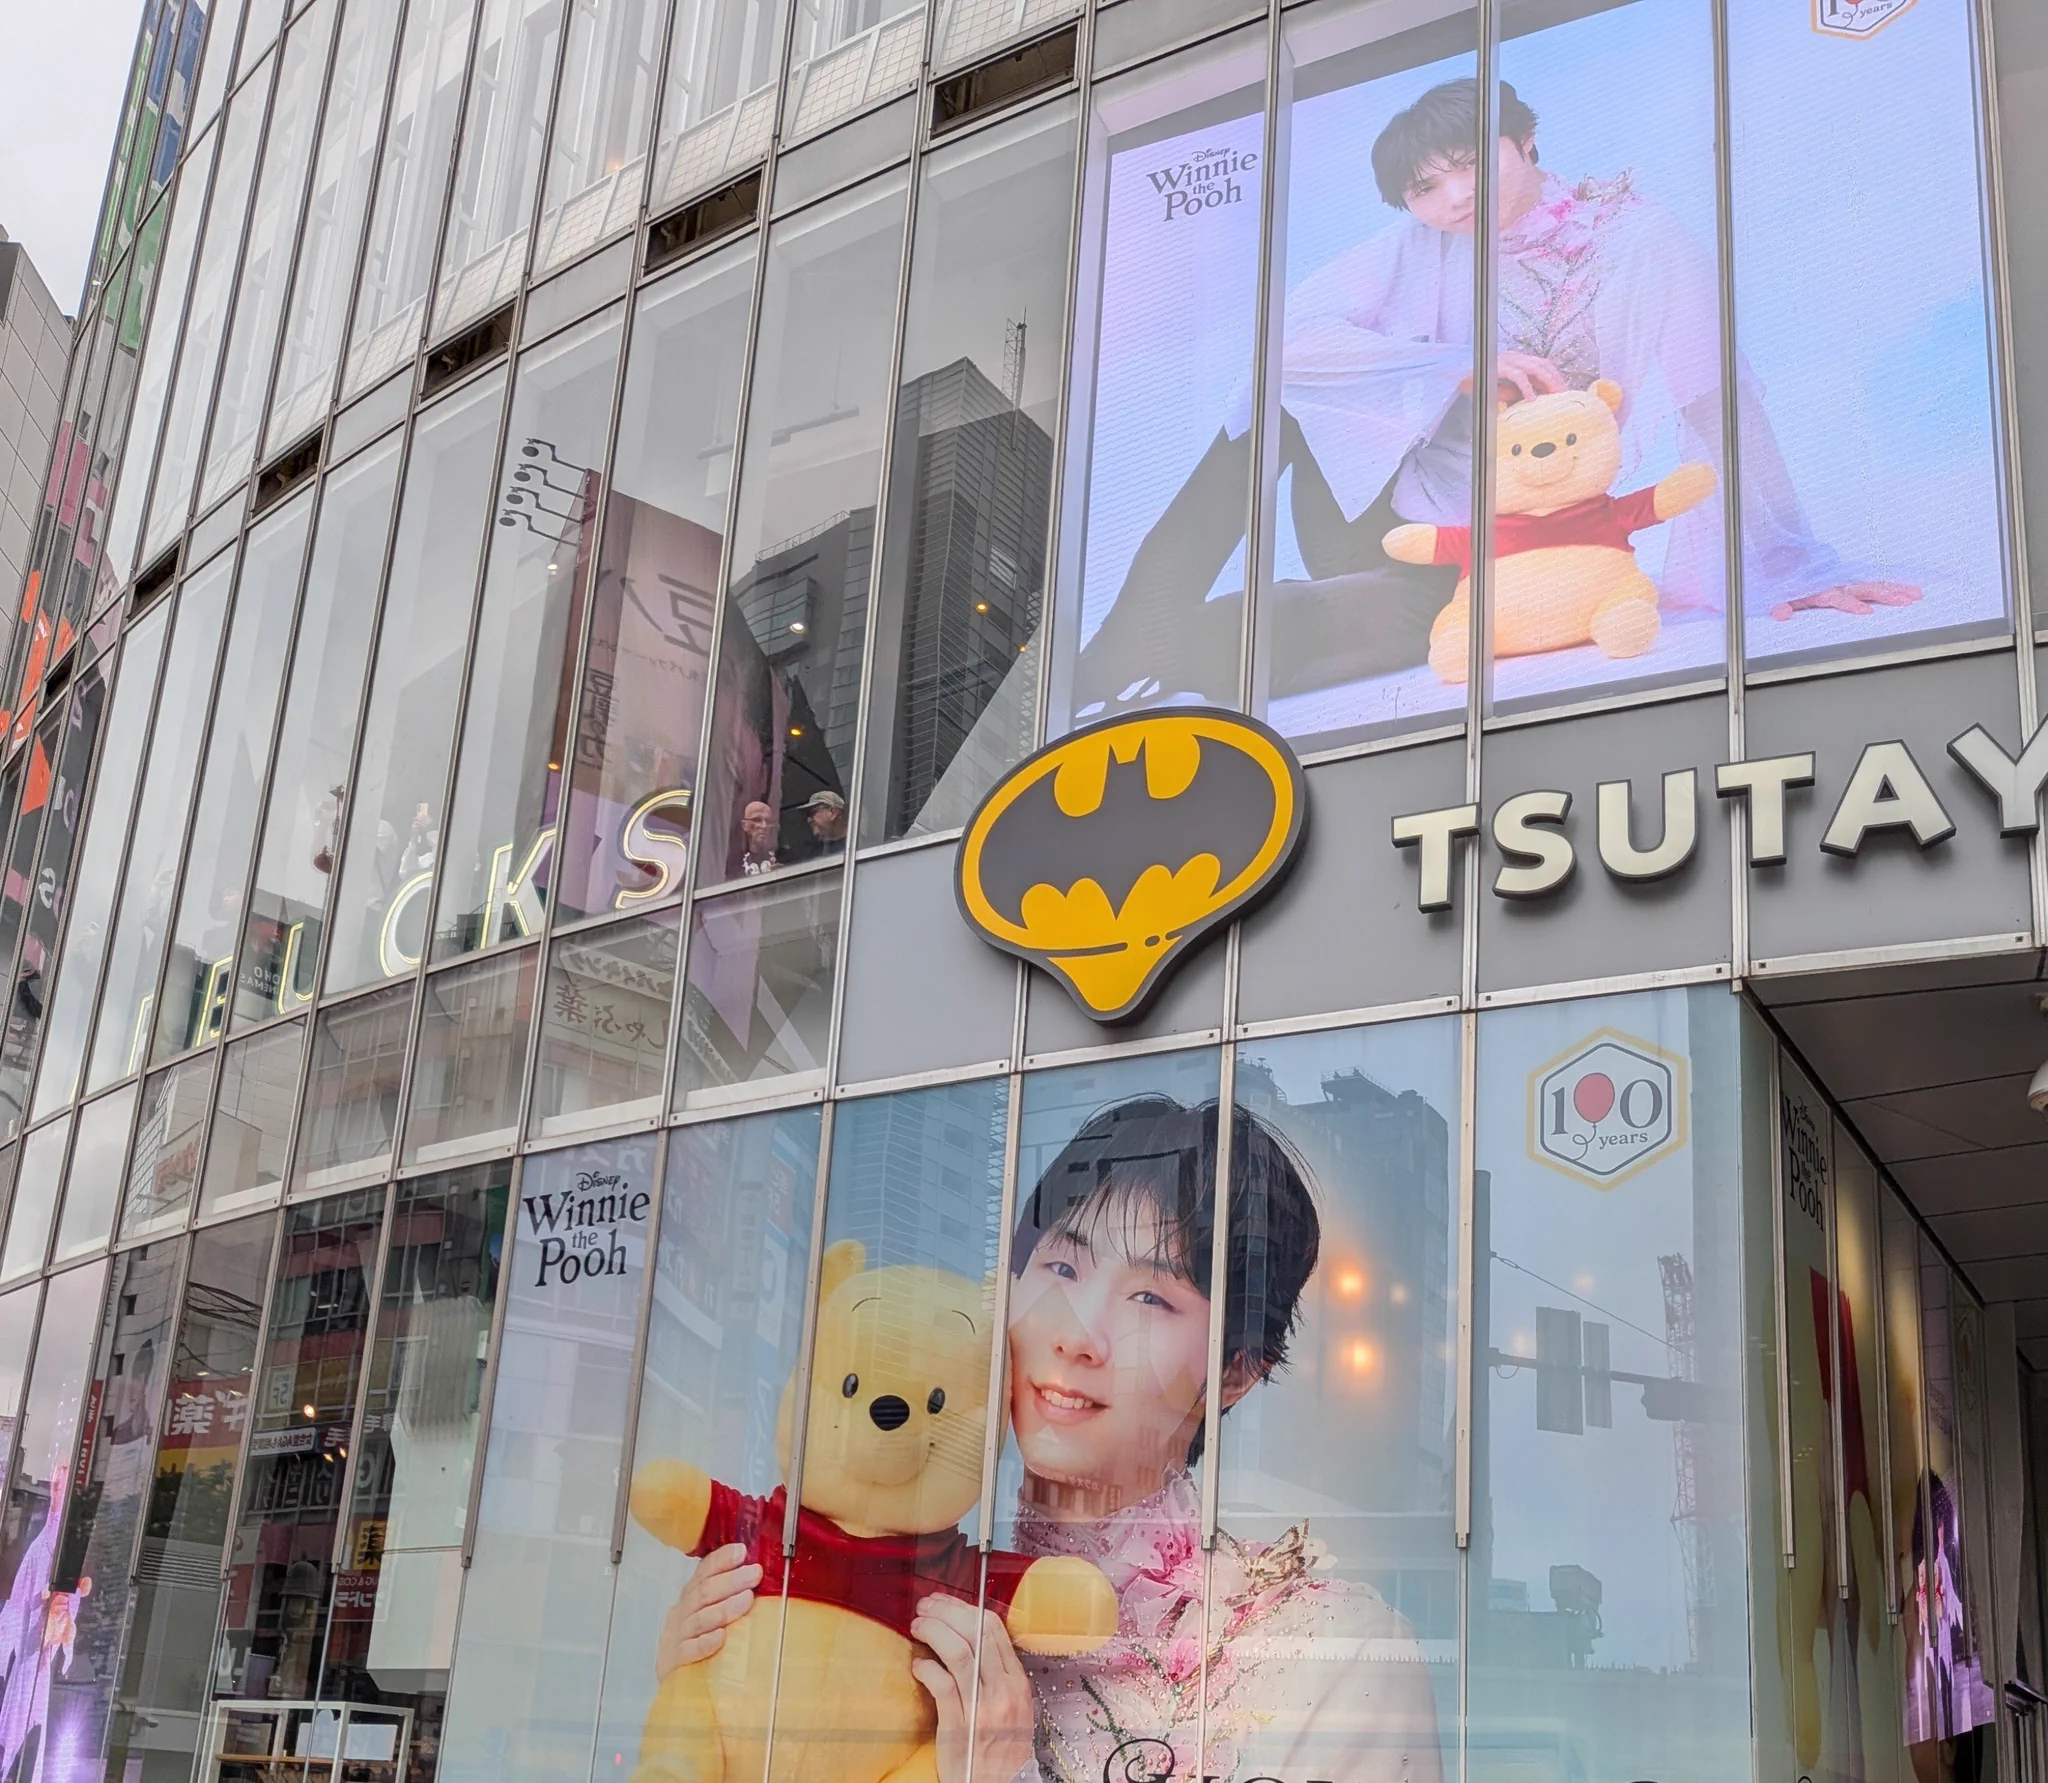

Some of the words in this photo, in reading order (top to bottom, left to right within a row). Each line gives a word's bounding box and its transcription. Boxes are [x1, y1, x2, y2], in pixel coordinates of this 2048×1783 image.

[1860, 3, 1893, 18] years
[1146, 151, 1258, 194] Winnie
[1192, 181, 1216, 195] the
[1163, 177, 1243, 222] Pooh
[1391, 721, 2048, 914] TSUTAY
[1598, 1131, 1649, 1150] years
[1782, 1094, 1827, 1186] Winnie
[575, 1170, 622, 1192] Disney
[1788, 1145, 1825, 1232] Pooh
[522, 1182, 651, 1236] Winnie
[534, 1228, 627, 1288] Pooh
[571, 1230, 598, 1249] the
